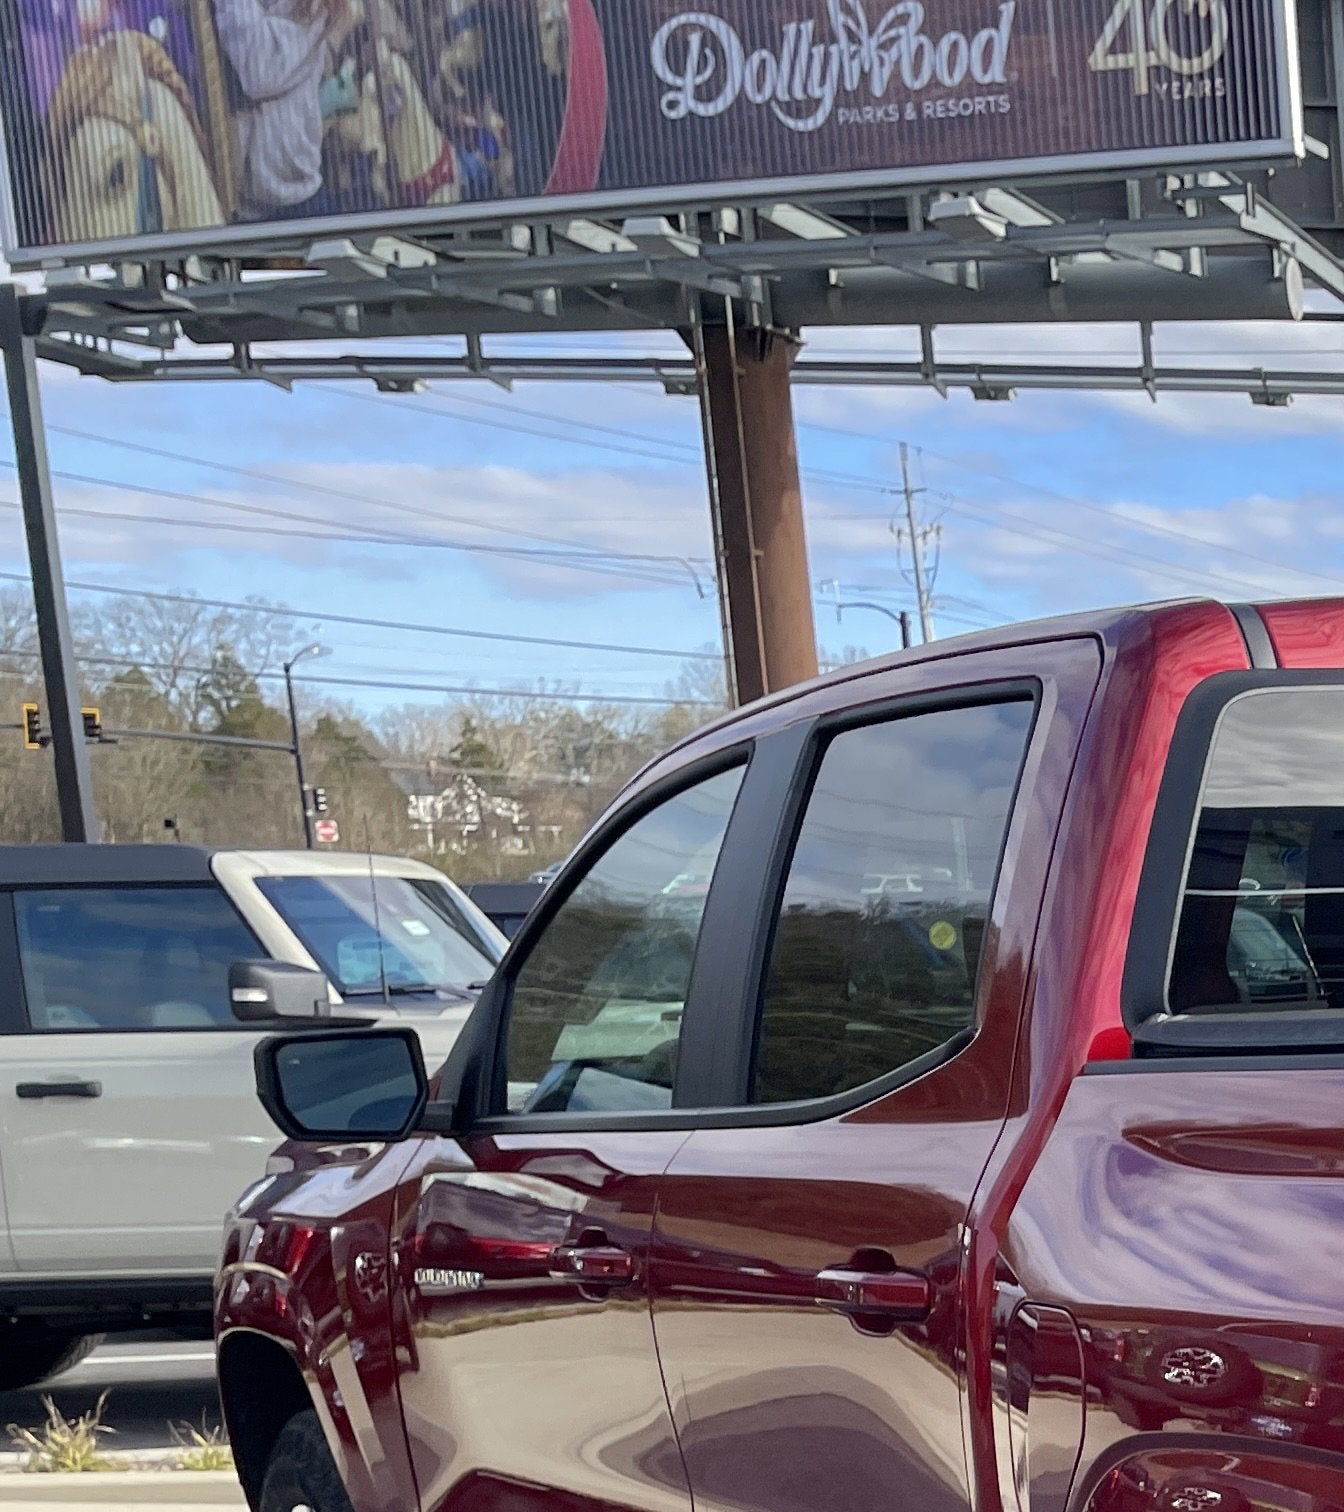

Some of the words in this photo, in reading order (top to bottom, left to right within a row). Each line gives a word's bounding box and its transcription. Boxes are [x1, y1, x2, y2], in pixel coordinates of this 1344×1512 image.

[1088, 0, 1228, 95] 40
[1154, 77, 1226, 100] YEARS
[837, 103, 900, 126] PARKS
[904, 100, 918, 121] &
[923, 95, 1012, 119] RESORTS
